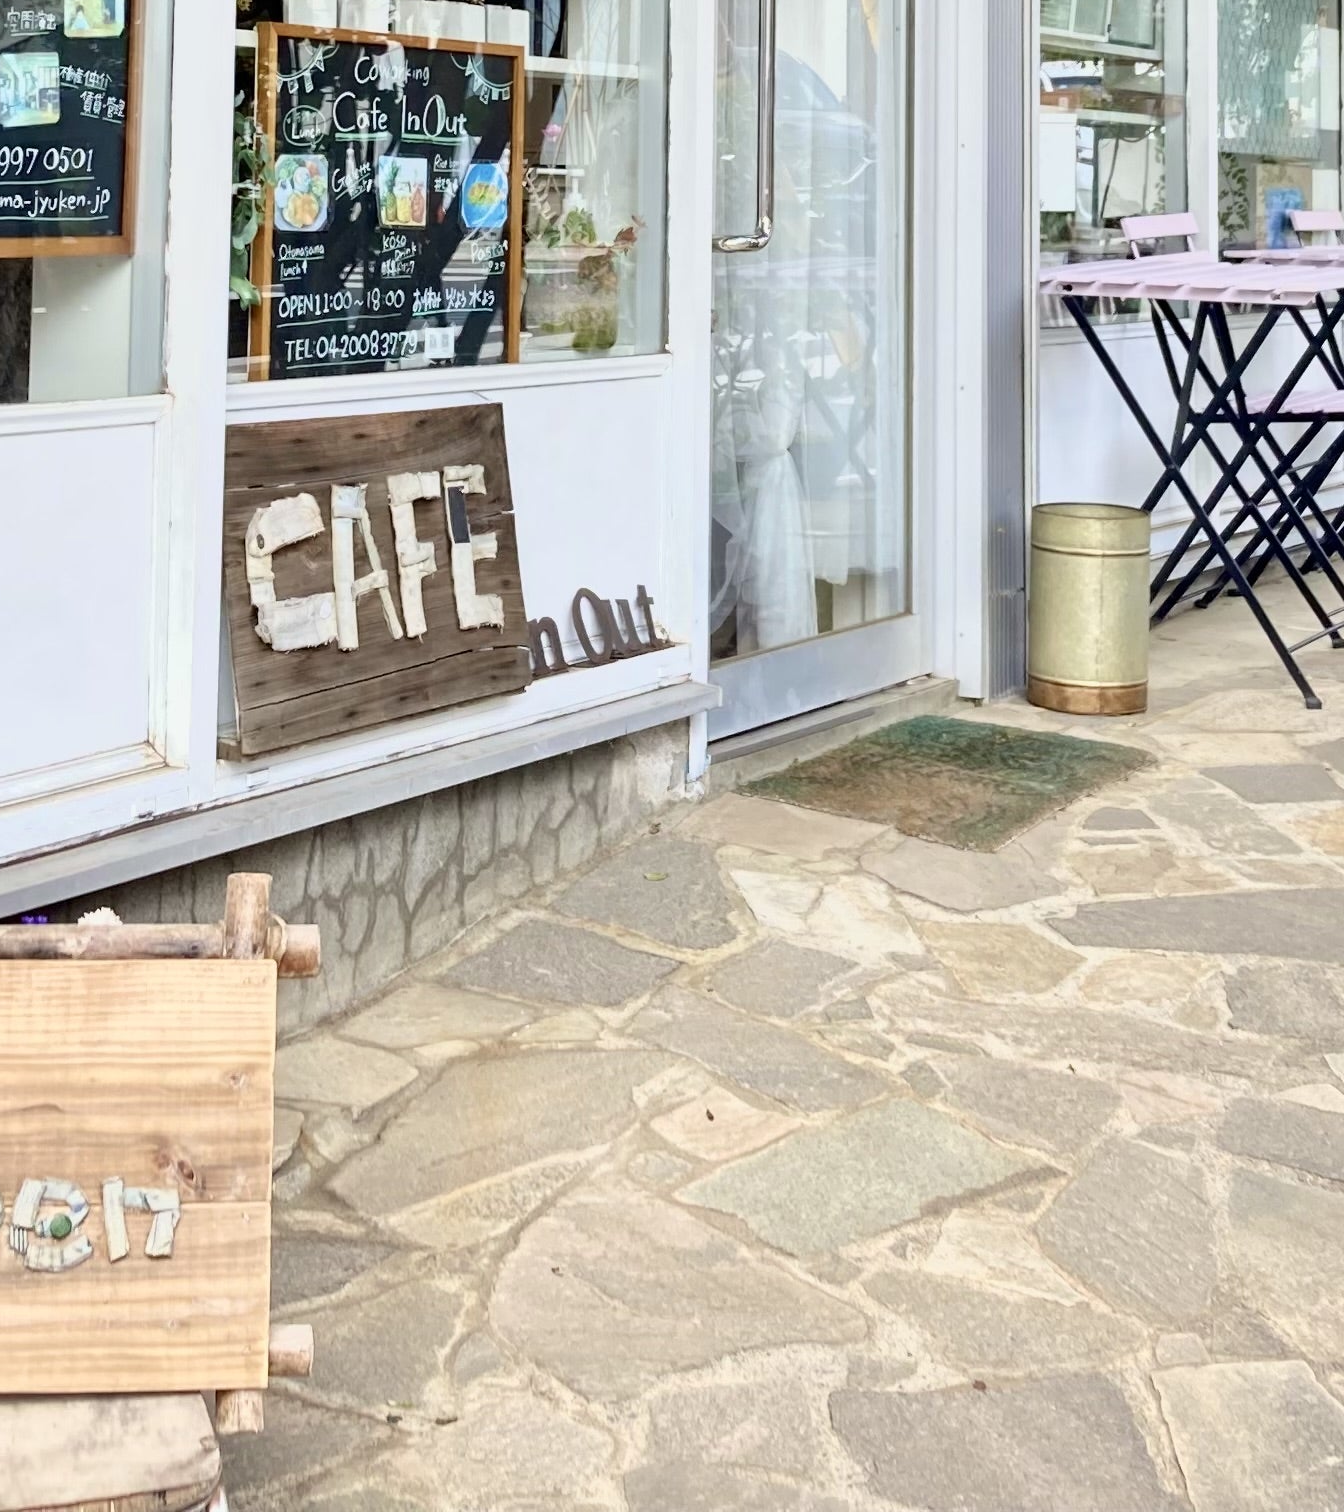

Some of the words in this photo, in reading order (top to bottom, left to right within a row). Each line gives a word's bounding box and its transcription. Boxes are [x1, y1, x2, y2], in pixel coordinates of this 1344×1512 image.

[333, 91, 389, 132] Cafe
[43, 146, 94, 174] 0501
[244, 462, 505, 653] CAFE
